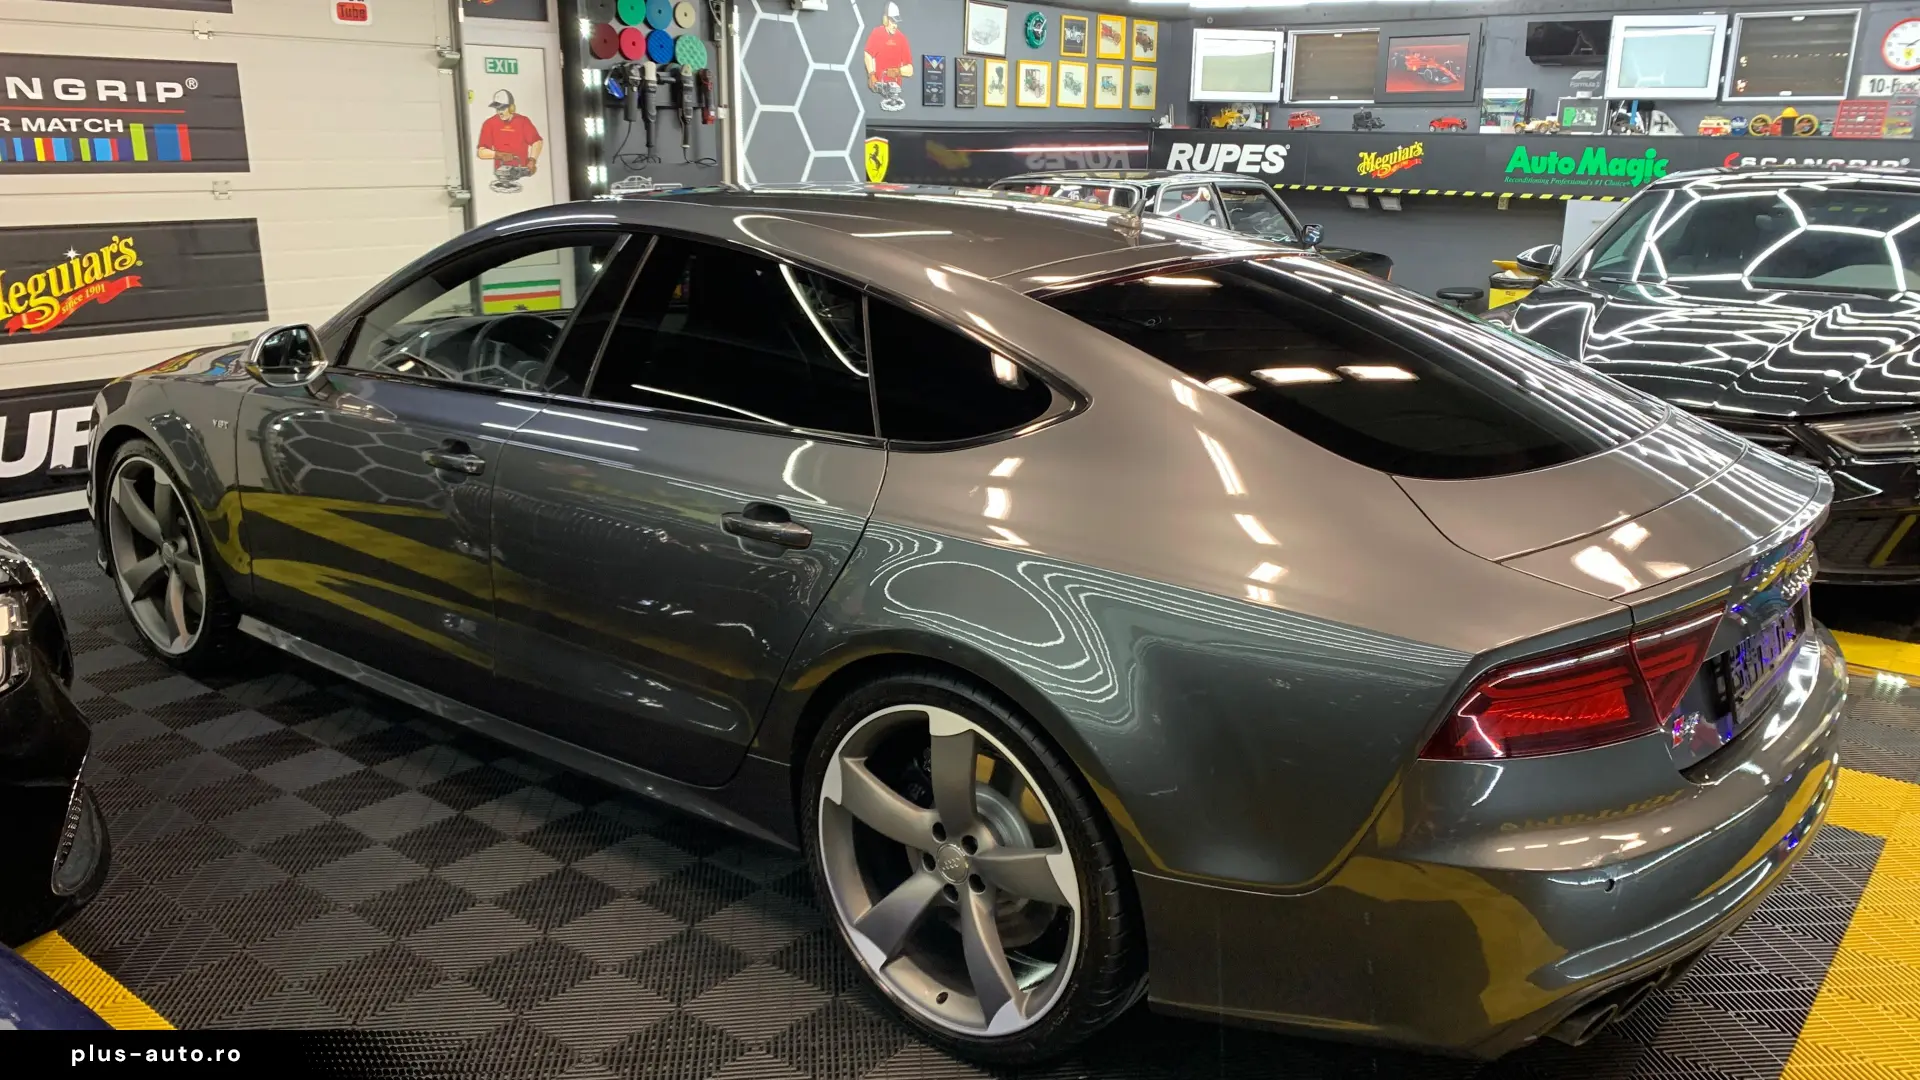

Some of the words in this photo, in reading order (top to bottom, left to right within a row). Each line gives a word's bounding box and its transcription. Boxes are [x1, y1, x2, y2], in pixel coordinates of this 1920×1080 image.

[340, 4, 366, 18] Tube
[486, 58, 517, 73] EXIT
[21, 117, 124, 133] MATCH
[1357, 141, 1424, 176] Meguiar's
[1504, 176, 1549, 185] Reconditioning
[1550, 177, 1593, 186] Professional's
[61, 294, 84, 314] since
[85, 283, 106, 299] 1901
